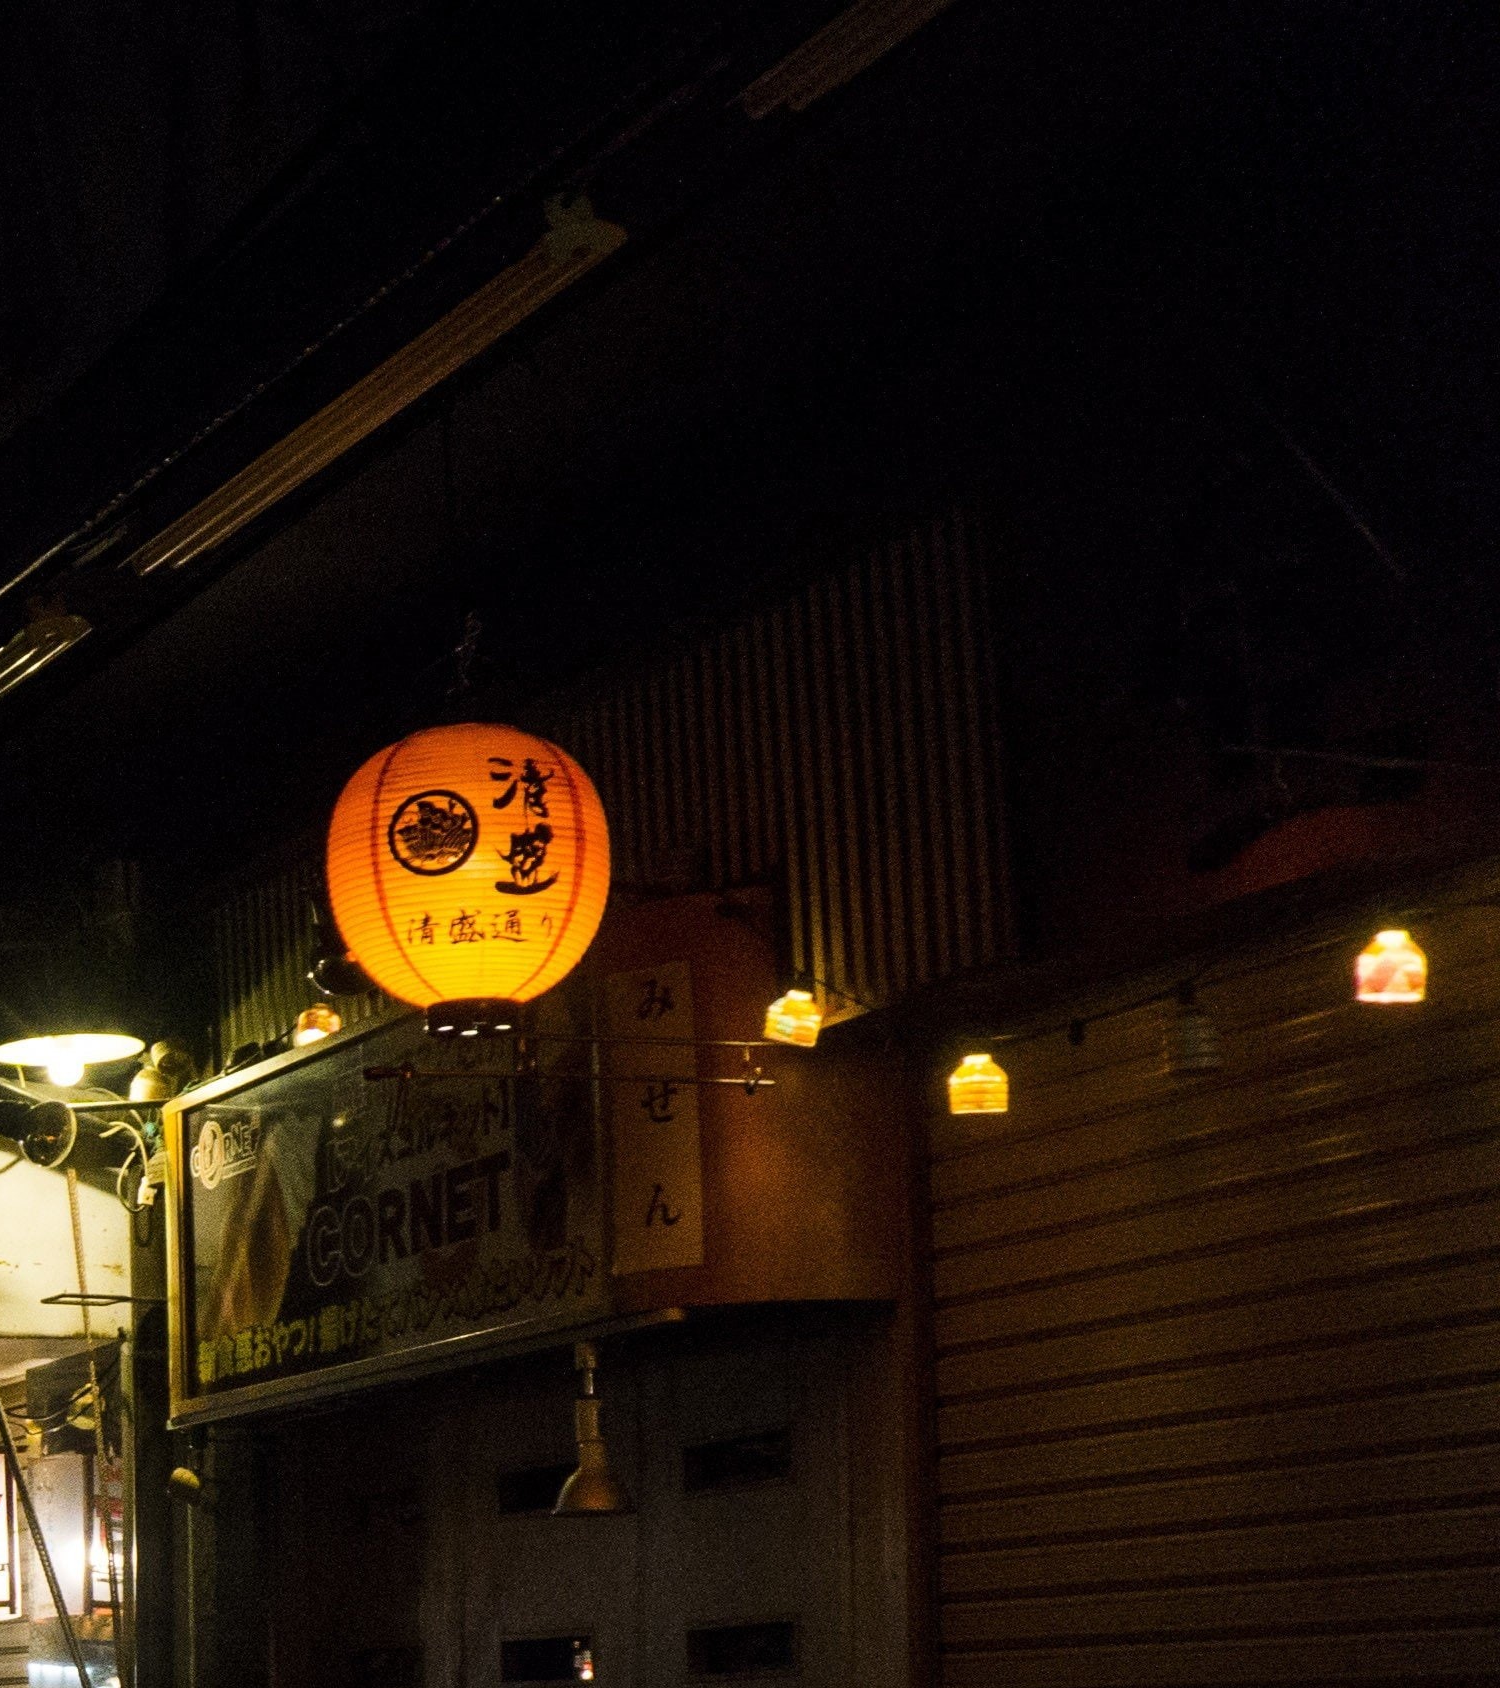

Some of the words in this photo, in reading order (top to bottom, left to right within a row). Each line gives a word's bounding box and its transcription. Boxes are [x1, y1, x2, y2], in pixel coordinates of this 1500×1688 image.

[405, 908, 555, 945] 清盛通り
[636, 978, 681, 1228] みせん
[305, 1151, 512, 1288] CORNET
